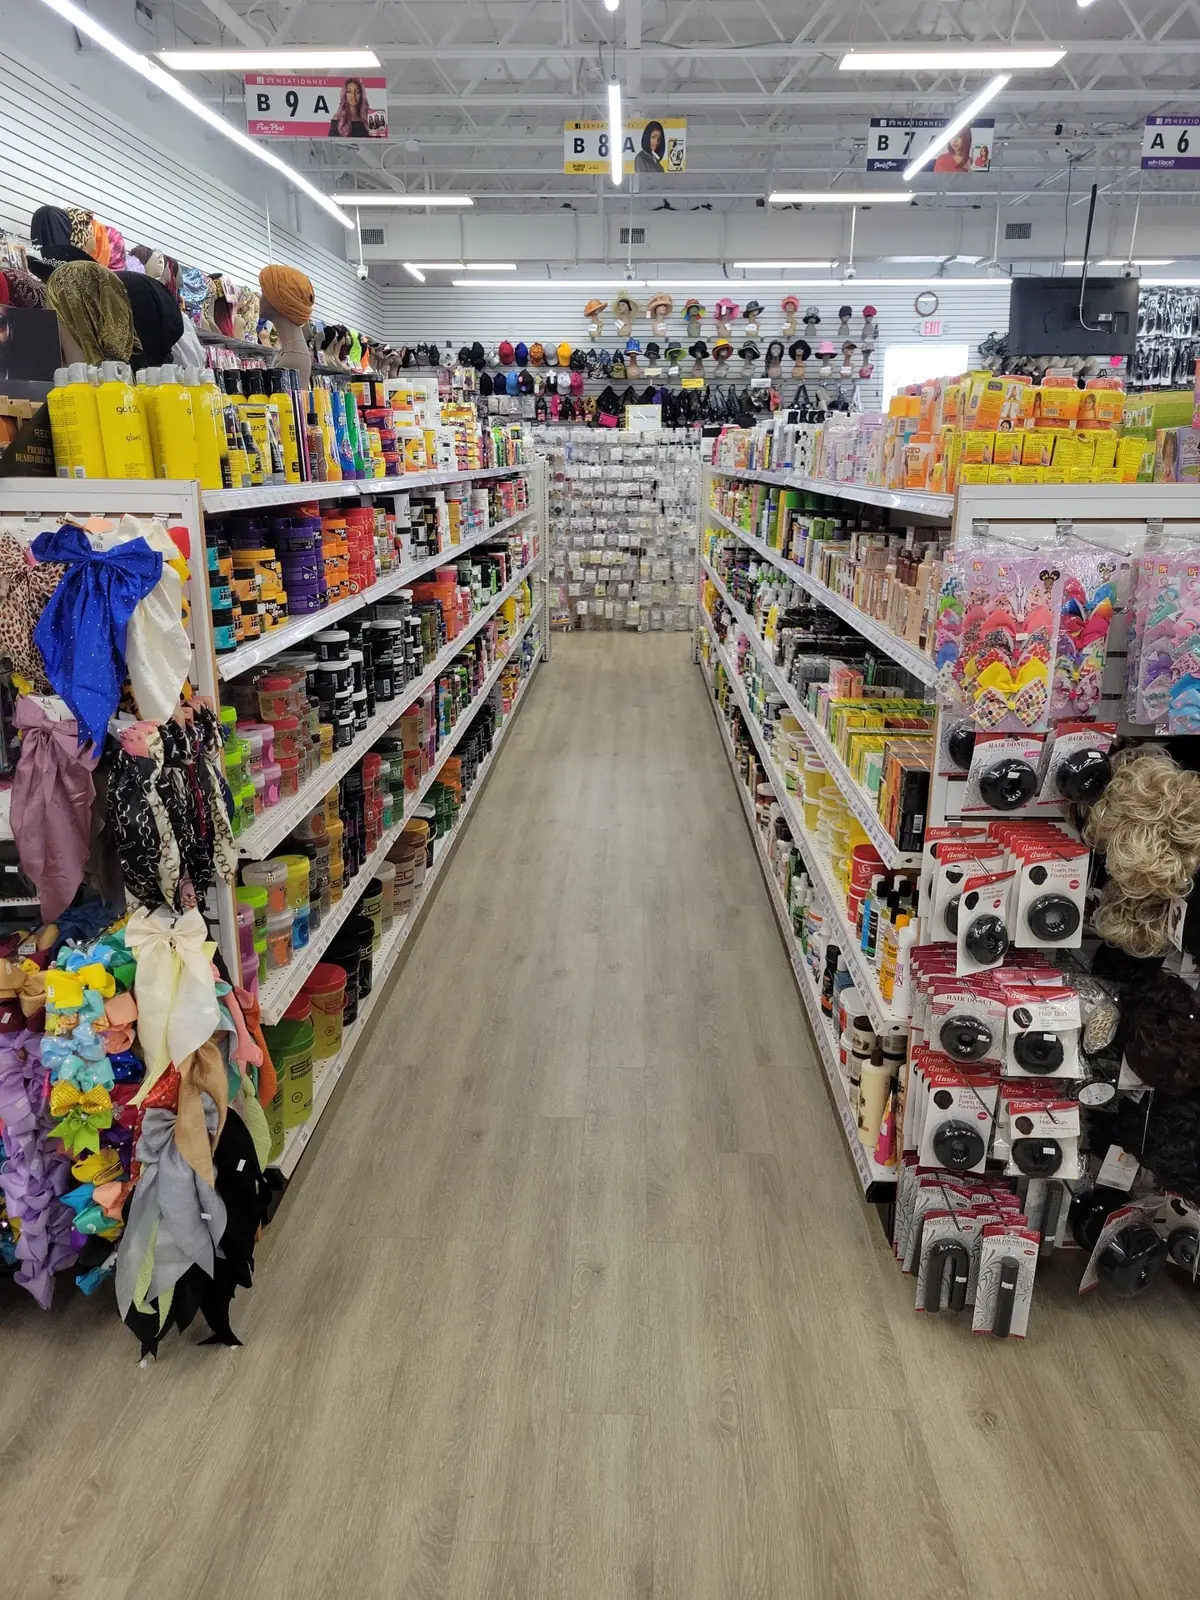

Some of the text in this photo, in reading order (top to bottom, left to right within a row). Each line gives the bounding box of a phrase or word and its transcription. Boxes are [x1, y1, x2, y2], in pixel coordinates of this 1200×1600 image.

[266, 77, 328, 85] SENSATIONNEL
[256, 90, 330, 117] B 9 A
[573, 133, 636, 157] B 8 A
[877, 135, 889, 151] B
[902, 131, 916, 155] 7
[1150, 129, 1190, 154] A 6
[946, 994, 993, 1006] HAIR DONUT
[928, 1065, 951, 1073] Annie
[935, 1074, 959, 1083] Annie
